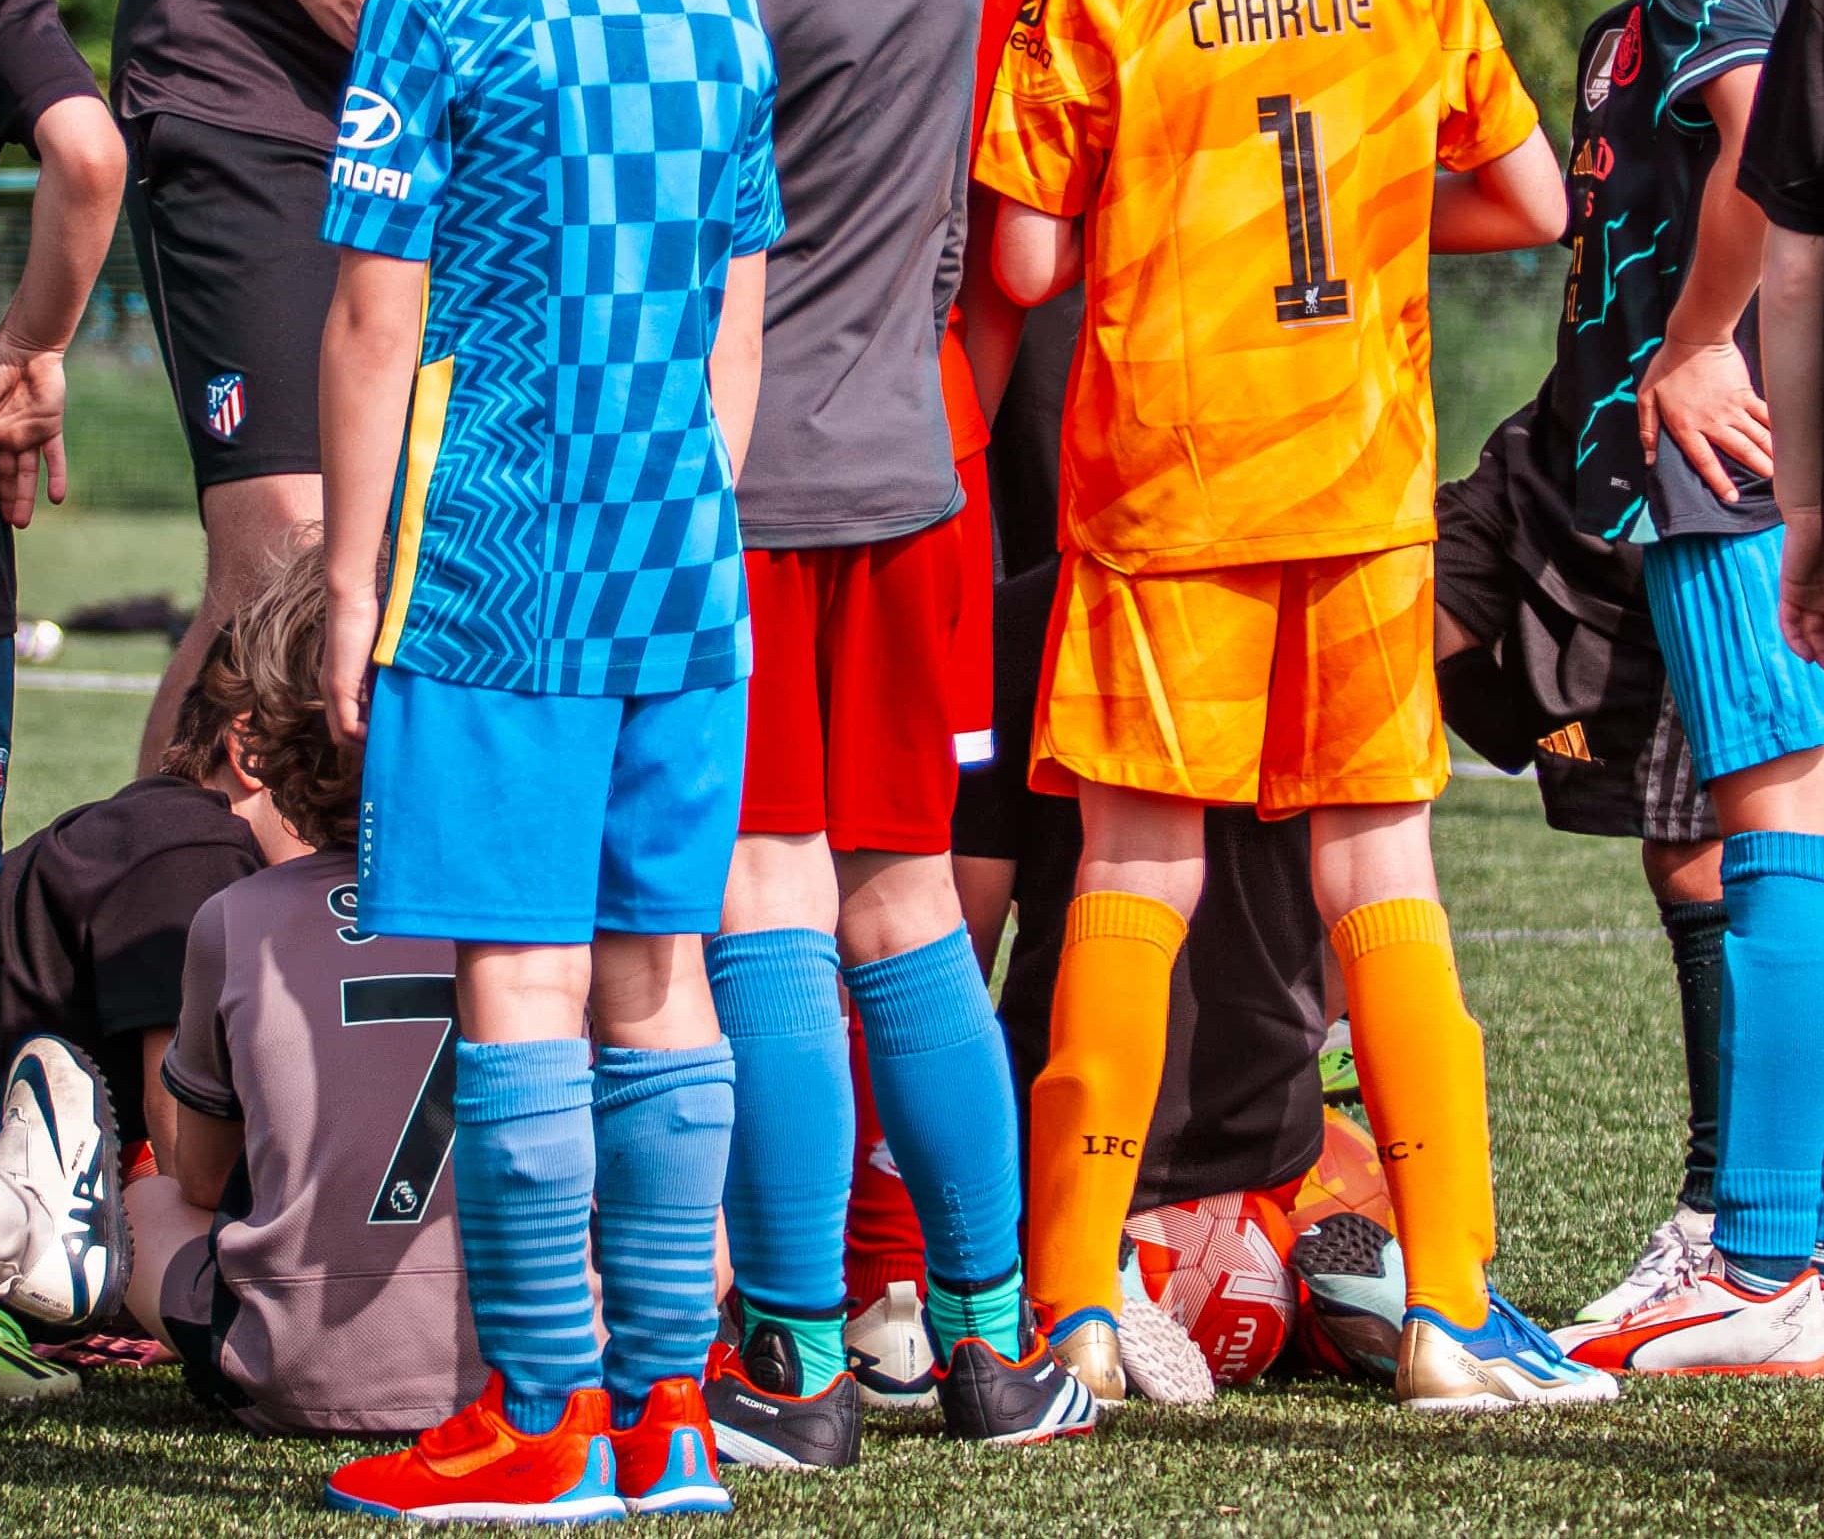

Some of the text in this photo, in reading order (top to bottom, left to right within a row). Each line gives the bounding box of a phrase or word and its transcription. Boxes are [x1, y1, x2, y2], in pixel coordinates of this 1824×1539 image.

[1257, 94, 1354, 328] 1
[363, 801, 374, 879] KIPSTA
[340, 974, 457, 1225] 7
[1081, 1134, 1138, 1159] LFC
